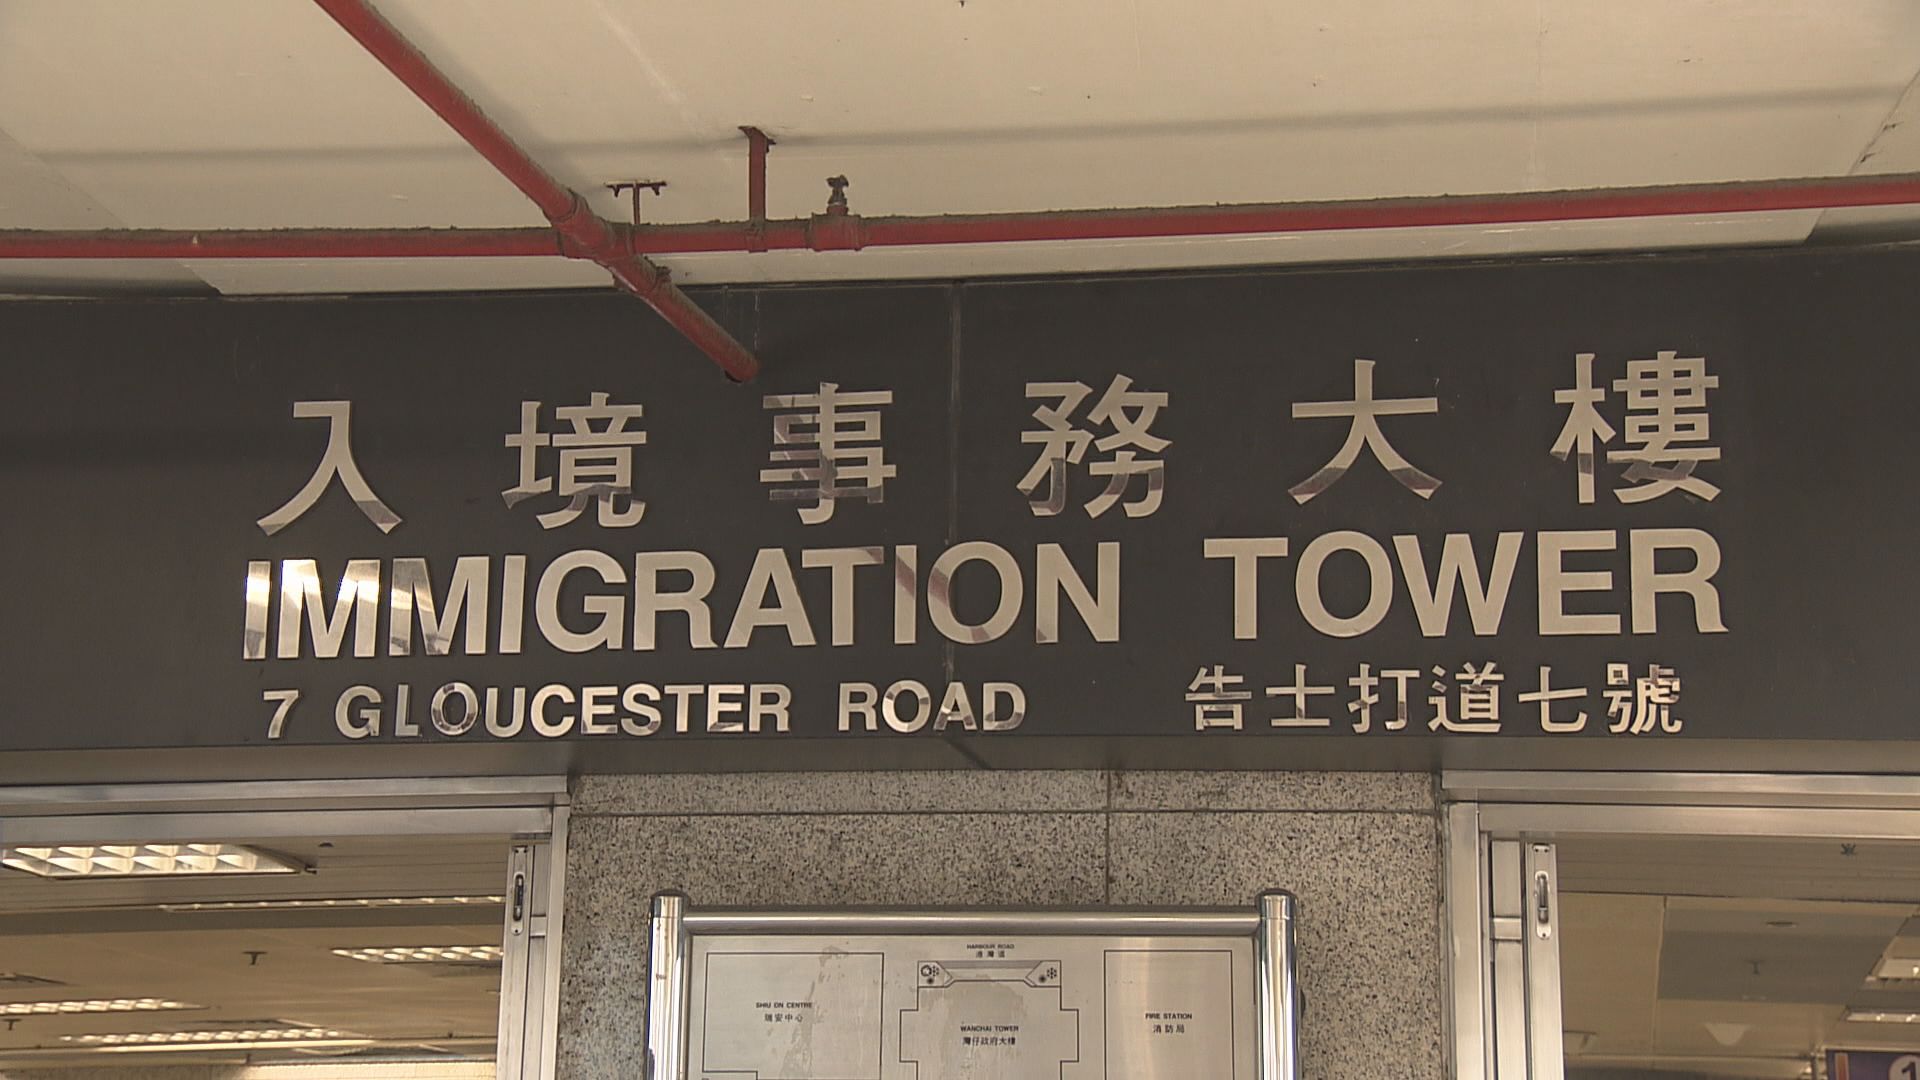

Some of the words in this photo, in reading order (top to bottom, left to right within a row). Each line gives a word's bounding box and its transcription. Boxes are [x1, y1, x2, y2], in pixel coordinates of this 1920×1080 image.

[256, 350, 1722, 537] 入境事務大樓
[243, 541, 1120, 660] IMMIGRATION
[1203, 529, 1728, 640] TOWER
[262, 689, 300, 739] 7
[335, 682, 792, 739] GLOUCESTER
[837, 679, 1026, 734] ROAD
[1184, 661, 1684, 735] 告士打道七號
[1145, 1012, 1160, 1020] FIRE
[1163, 1012, 1193, 1020] STATION
